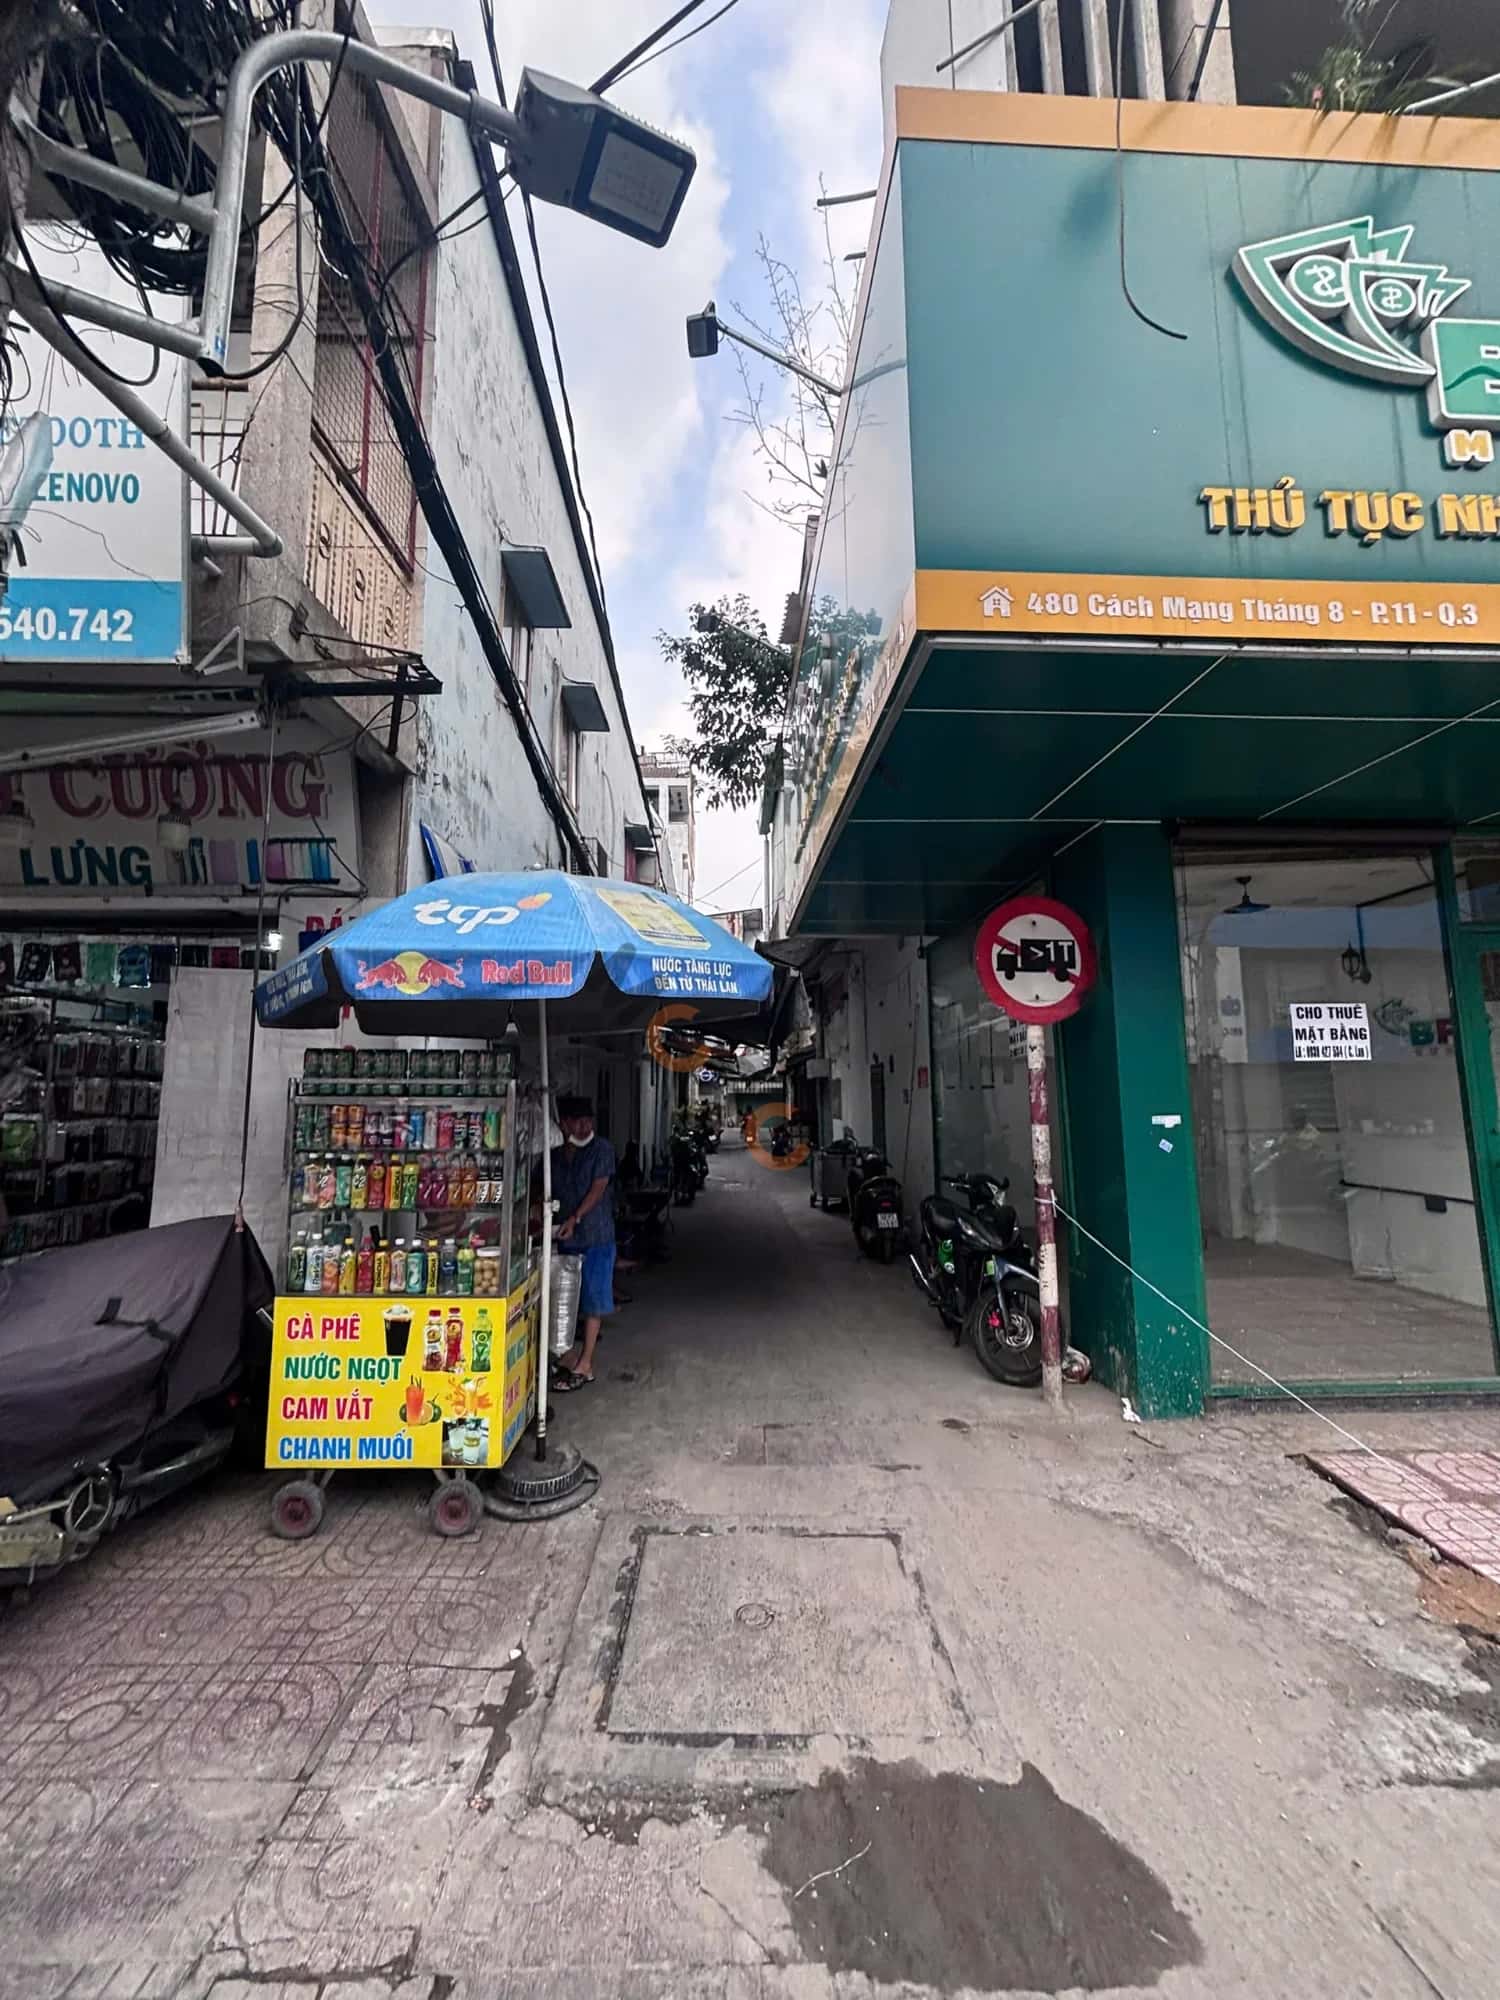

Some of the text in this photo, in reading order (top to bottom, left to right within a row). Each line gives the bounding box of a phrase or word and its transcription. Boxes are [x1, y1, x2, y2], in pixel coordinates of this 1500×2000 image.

[1201, 475, 1306, 533] THỦ
[1319, 490, 1425, 543] TỤC
[1027, 592, 1079, 615] 480
[1088, 593, 1154, 617] Cách
[1162, 596, 1234, 623] Mạng
[1241, 597, 1321, 625] Tháng
[1328, 601, 1345, 623] 8
[1371, 601, 1418, 625] P.11
[1439, 602, 1479, 627] Q.3
[48, 740, 328, 819] CƯỜNG
[20, 839, 153, 886] LƯNG
[413, 899, 521, 934] tcp
[481, 959, 573, 985] Red Bull
[652, 955, 732, 979] NƯỚC TĂNG LỰC
[654, 972, 738, 993] ĐẾN TỪ THÁI LAN
[1296, 1003, 1363, 1019] CHO THUÊ
[1295, 1025, 1325, 1044] MẶT
[287, 1312, 361, 1340] CÀ PHÊ
[284, 1352, 403, 1386] NƯỚC NGỌT
[282, 1388, 373, 1420] CAM VẮT
[280, 1428, 413, 1460] CHANH MUỐI
